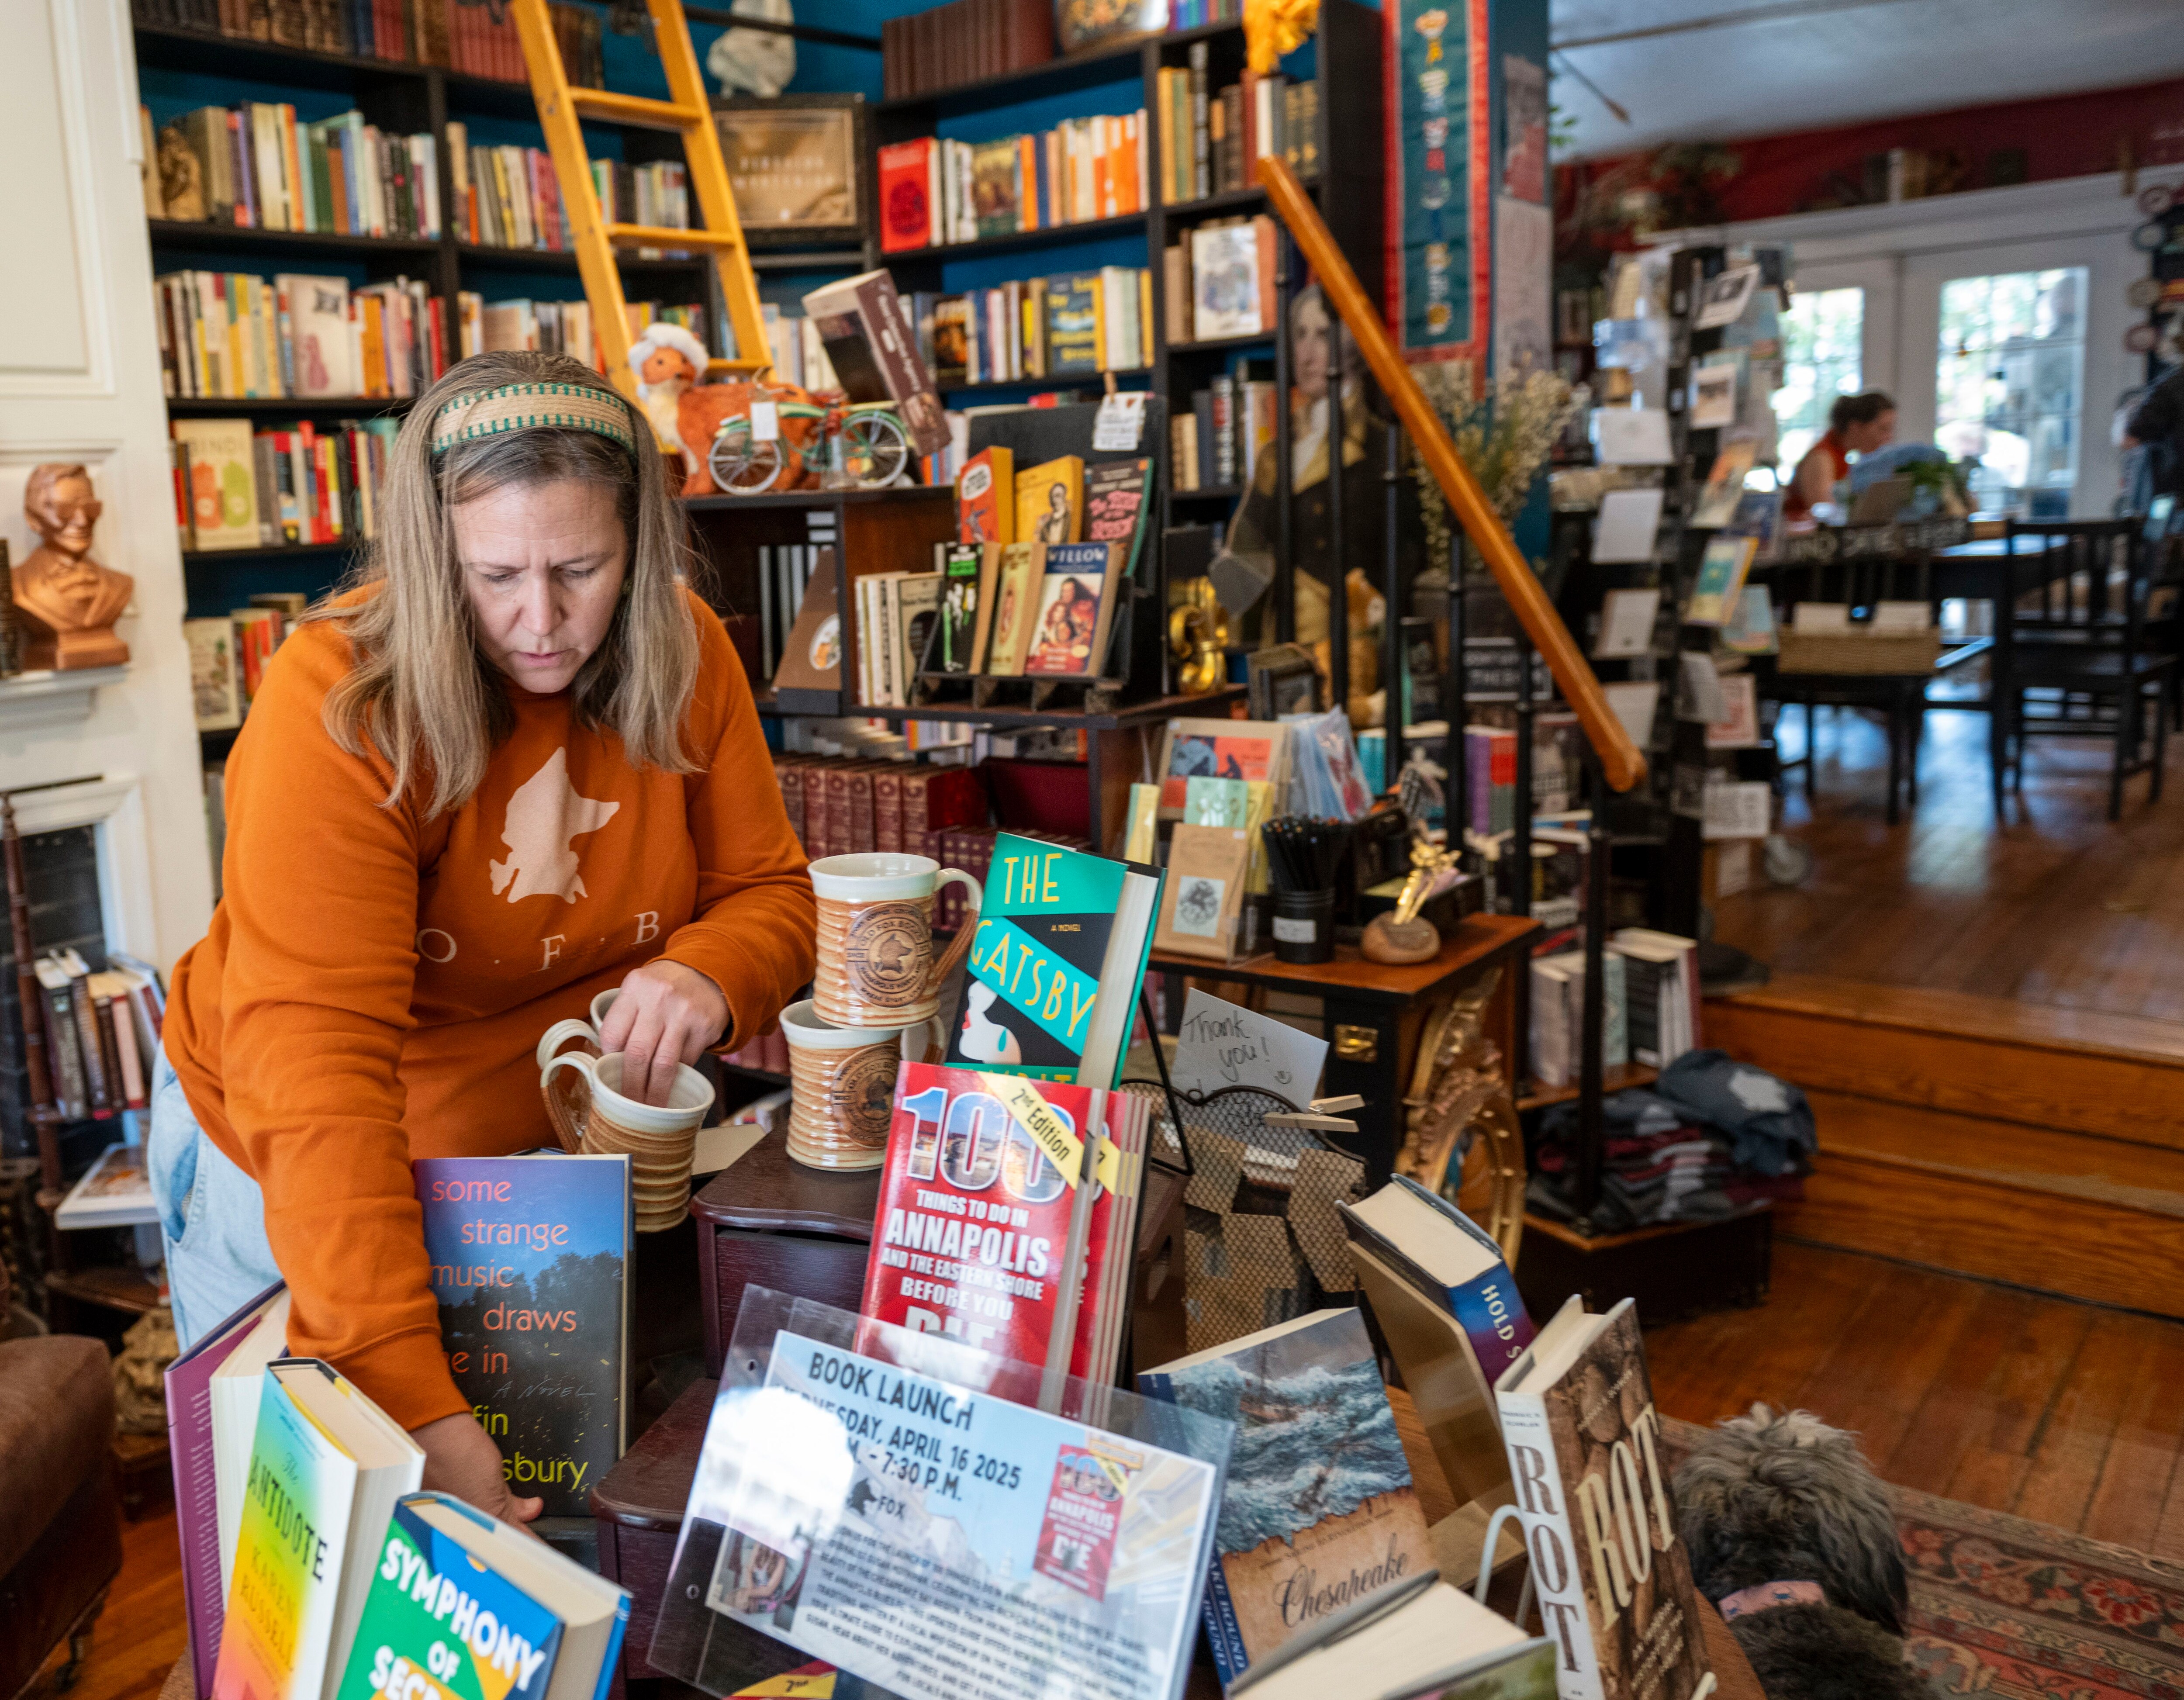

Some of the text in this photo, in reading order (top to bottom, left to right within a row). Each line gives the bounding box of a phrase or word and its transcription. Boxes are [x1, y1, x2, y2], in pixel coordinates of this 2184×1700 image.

[1004, 853, 1063, 904] THE
[1057, 923, 1082, 932] NOVEL
[970, 920, 1097, 1037] GATSBY
[1184, 1010, 1250, 1043] Thank
[1219, 1037, 1268, 1082] you!
[901, 1086, 1075, 1203] 100
[1026, 1106, 1071, 1162] Edition
[432, 1180, 512, 1202] some
[917, 1189, 1030, 1228] THINGS TO DO IN
[461, 1218, 569, 1251] strange
[885, 1207, 1051, 1278] ANNAPOLIS
[430, 1259, 514, 1288] music
[881, 1247, 909, 1269] AND
[910, 1253, 934, 1275] THE
[934, 1259, 994, 1290] EASTERN
[994, 1272, 1044, 1301] SHORE
[900, 1276, 1015, 1321] BEFORE YOU
[483, 1302, 577, 1332] draws
[1481, 1284, 1523, 1359] HOLD S
[483, 1344, 508, 1374] in
[492, 1380, 514, 1399] A
[808, 1352, 975, 1431] BOOK LAUNCH
[502, 1451, 589, 1491] sbury
[881, 1451, 920, 1484] 7:30
[924, 1466, 962, 1501] P.M.
[888, 1425, 943, 1464] APRIL
[950, 1444, 969, 1472] 16
[973, 1454, 1023, 1490] 2025
[248, 1455, 328, 1583] ANTIDOTE
[878, 1496, 906, 1520] FOX
[1574, 1402, 1675, 1631] ROT
[1271, 1531, 1409, 1629] Chesapeake
[1510, 1444, 1581, 1673] ROT
[380, 1538, 546, 1692] SYMPHONY
[427, 1640, 461, 1684] OF
